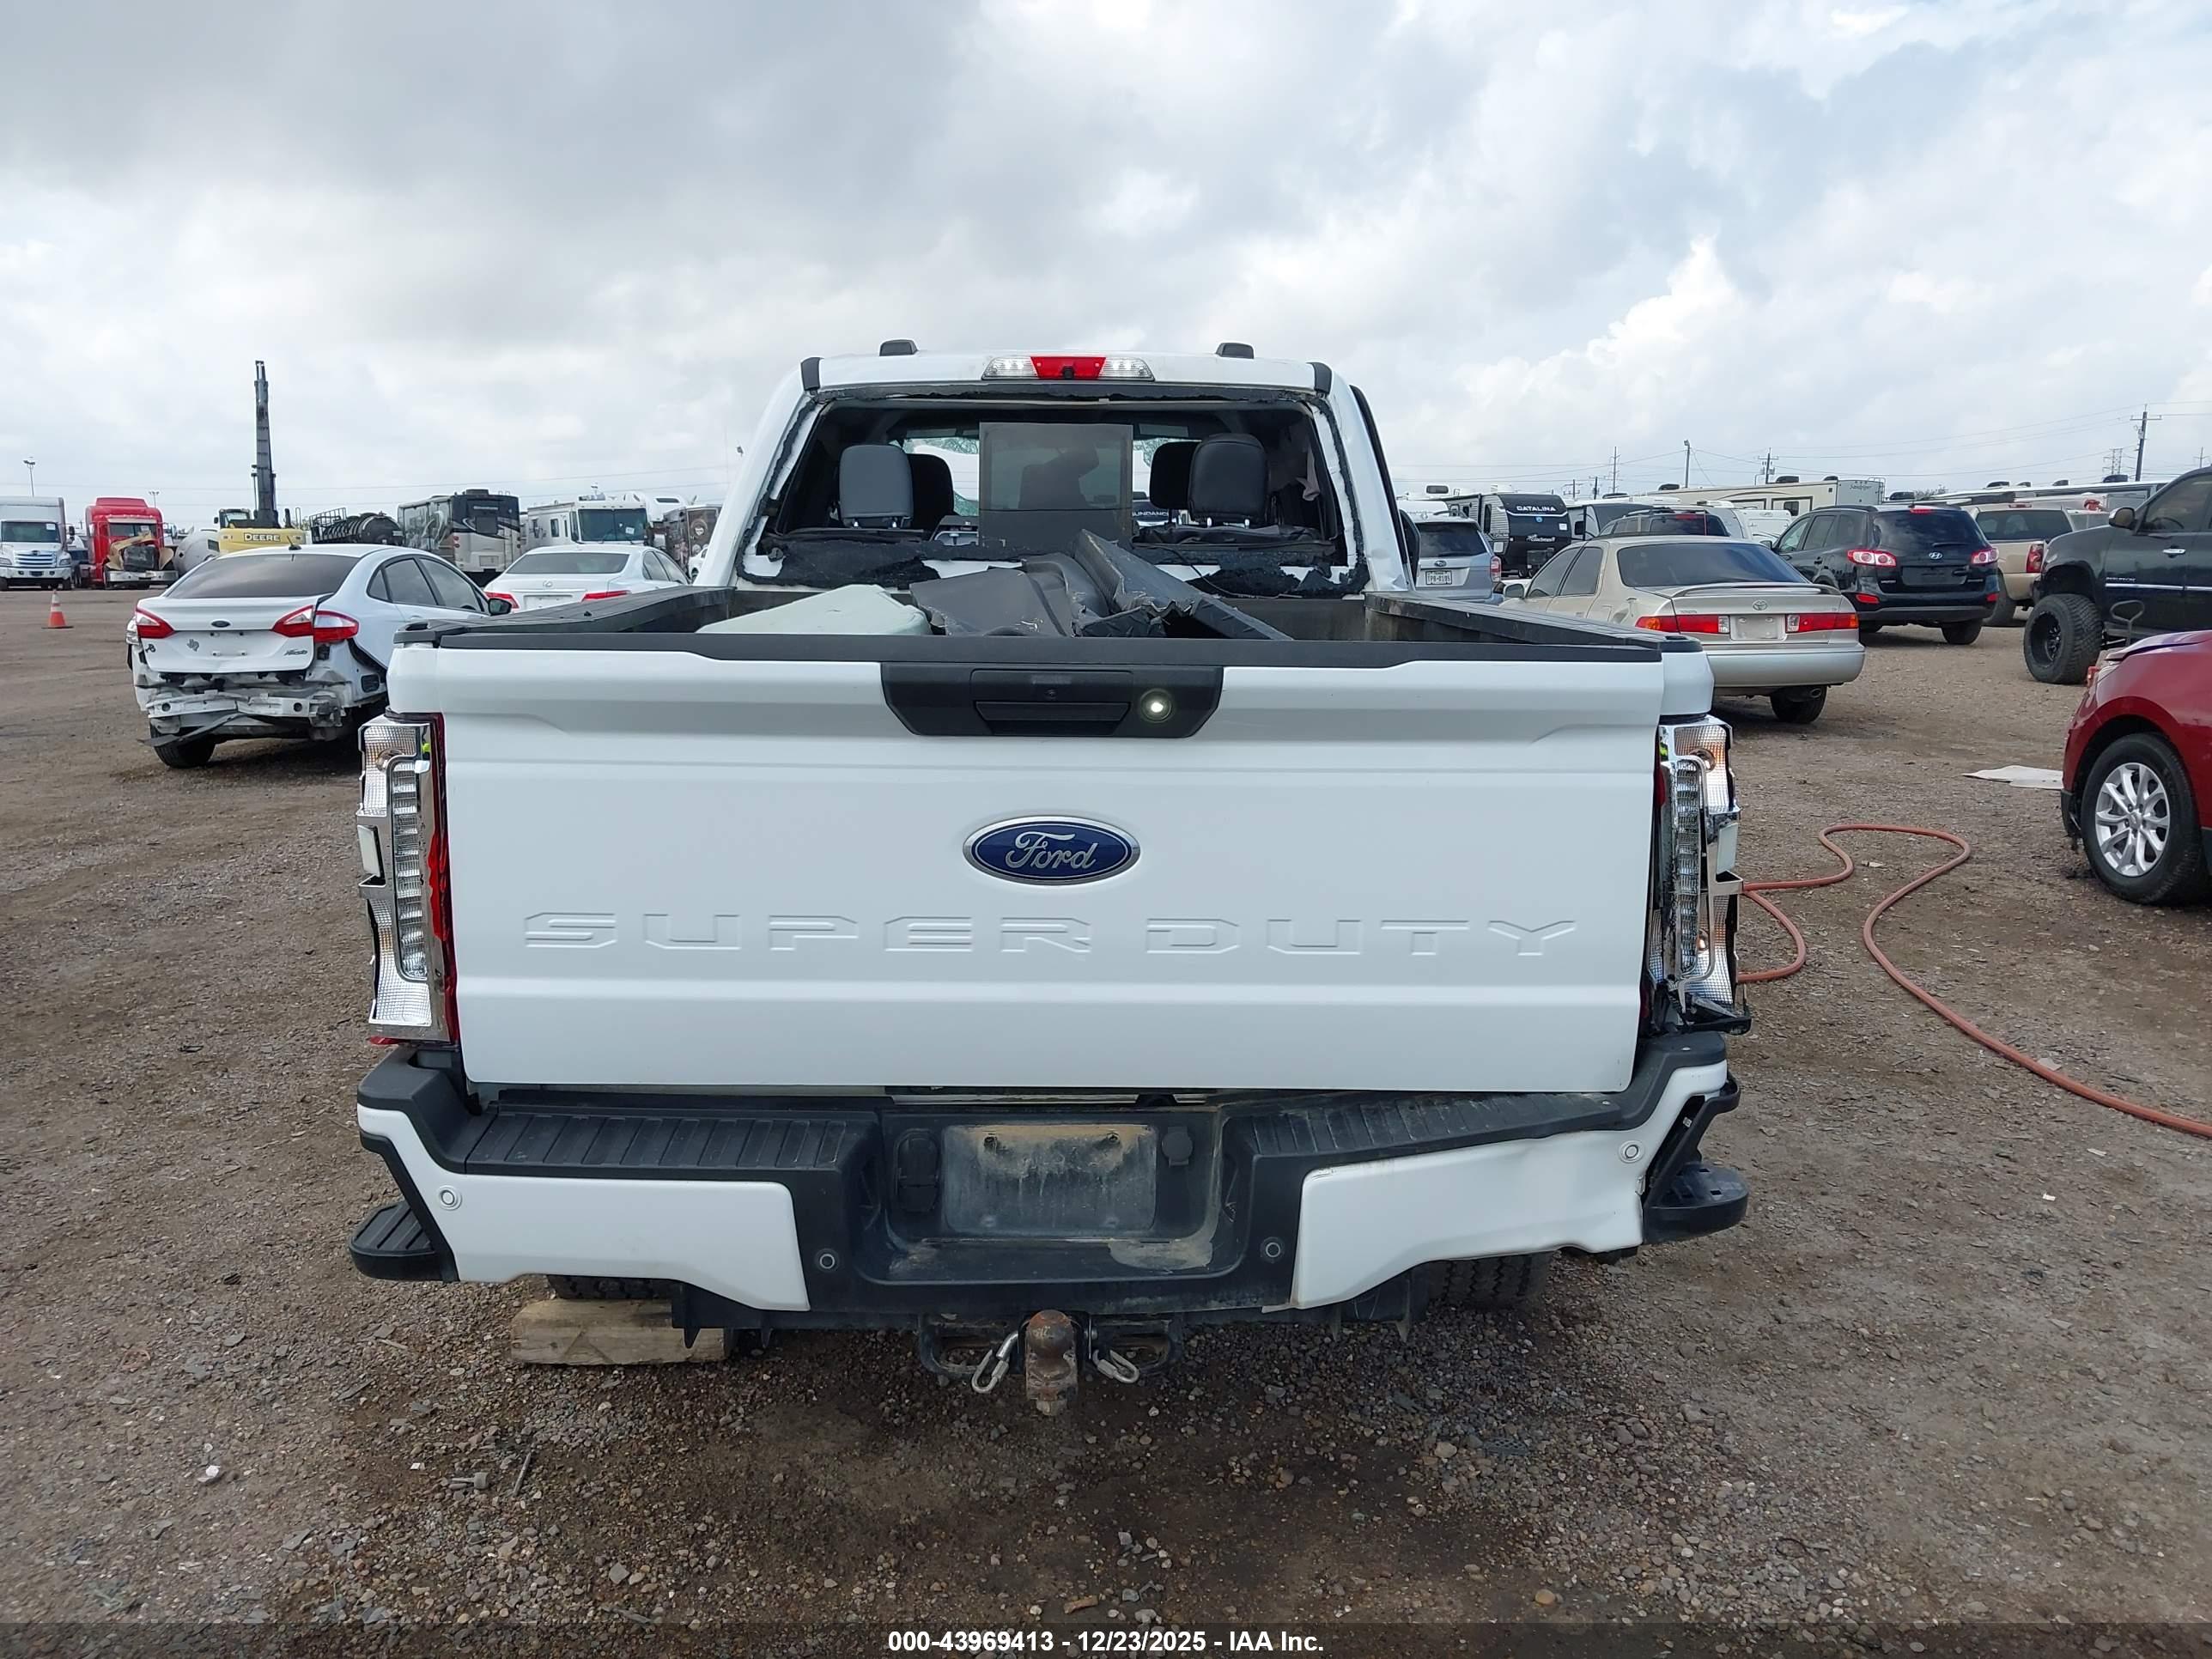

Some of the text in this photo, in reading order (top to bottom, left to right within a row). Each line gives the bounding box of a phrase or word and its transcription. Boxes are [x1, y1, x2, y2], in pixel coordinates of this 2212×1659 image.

[244, 532, 280, 541] DEERE
[1006, 831, 1098, 869] Ford
[526, 912, 1576, 956] SUPER DUTY
